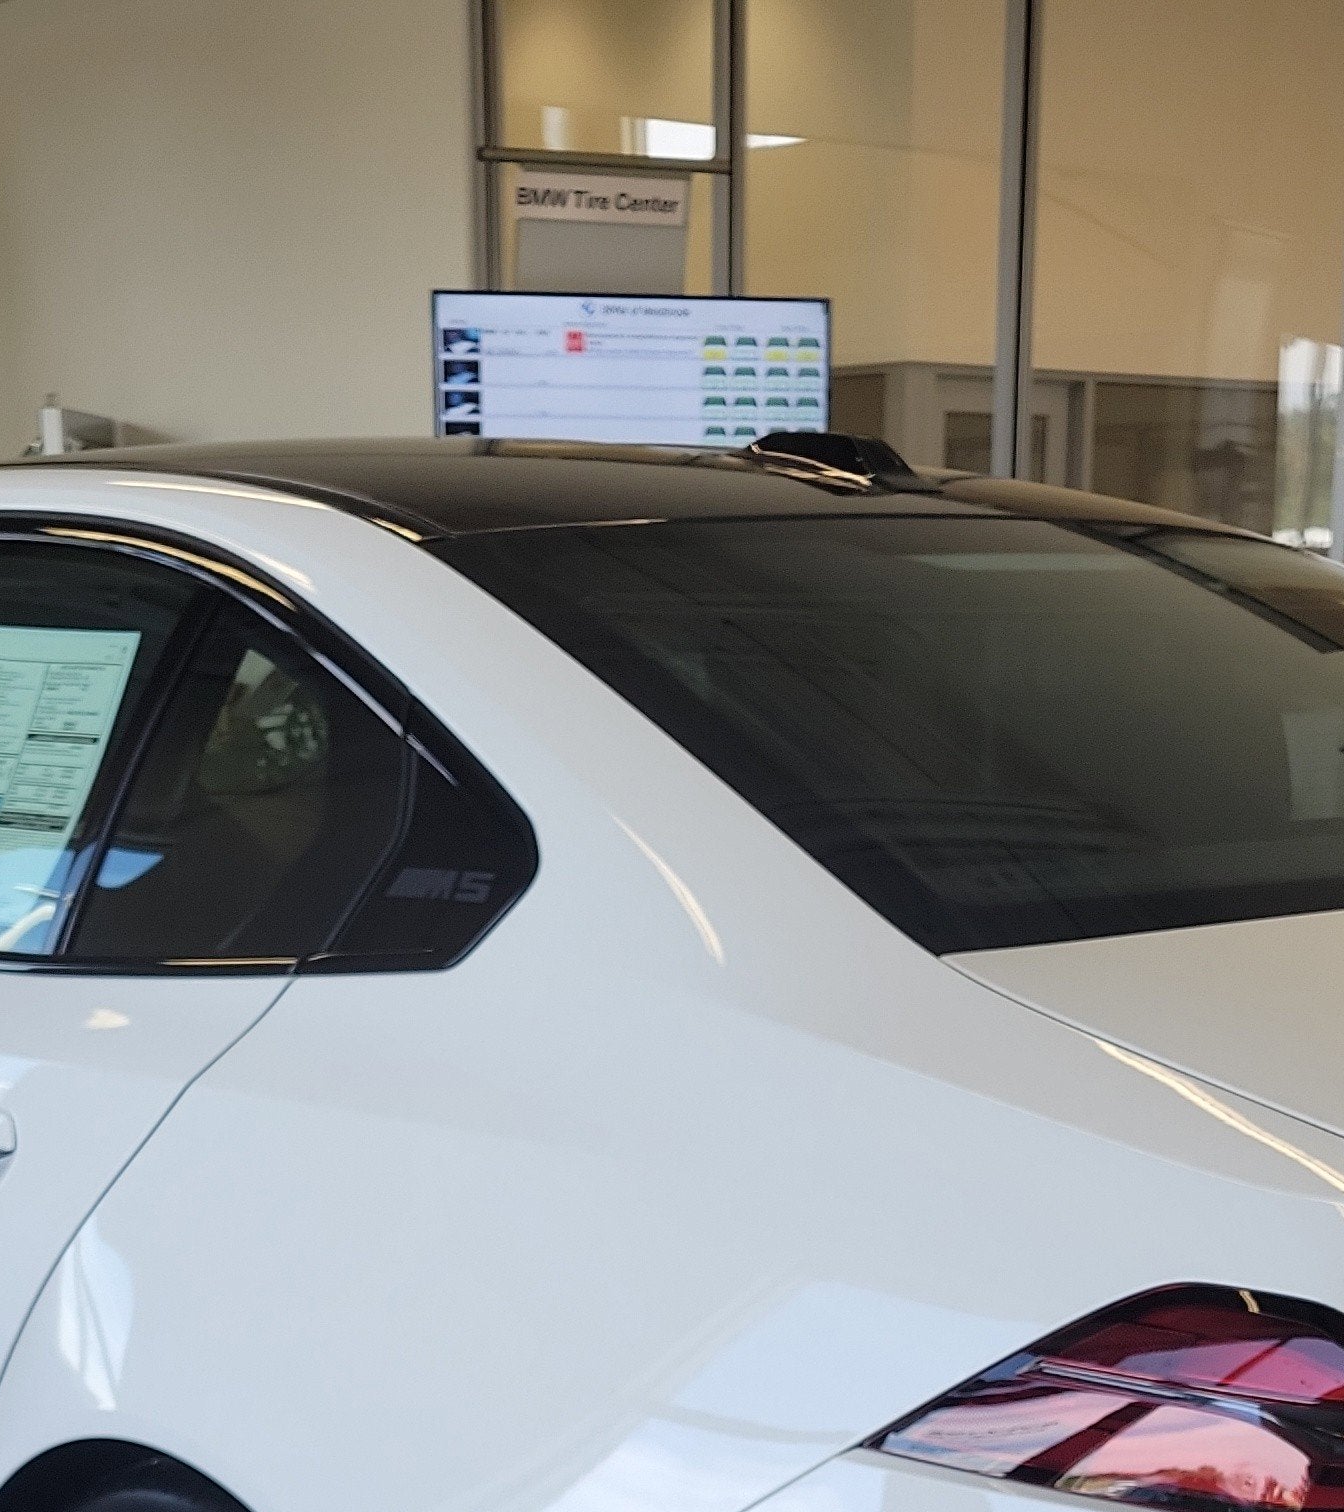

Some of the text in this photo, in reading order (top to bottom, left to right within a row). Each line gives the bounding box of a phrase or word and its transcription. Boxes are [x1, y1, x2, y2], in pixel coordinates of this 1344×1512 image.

[516, 187, 679, 213] BMW Tire Center
